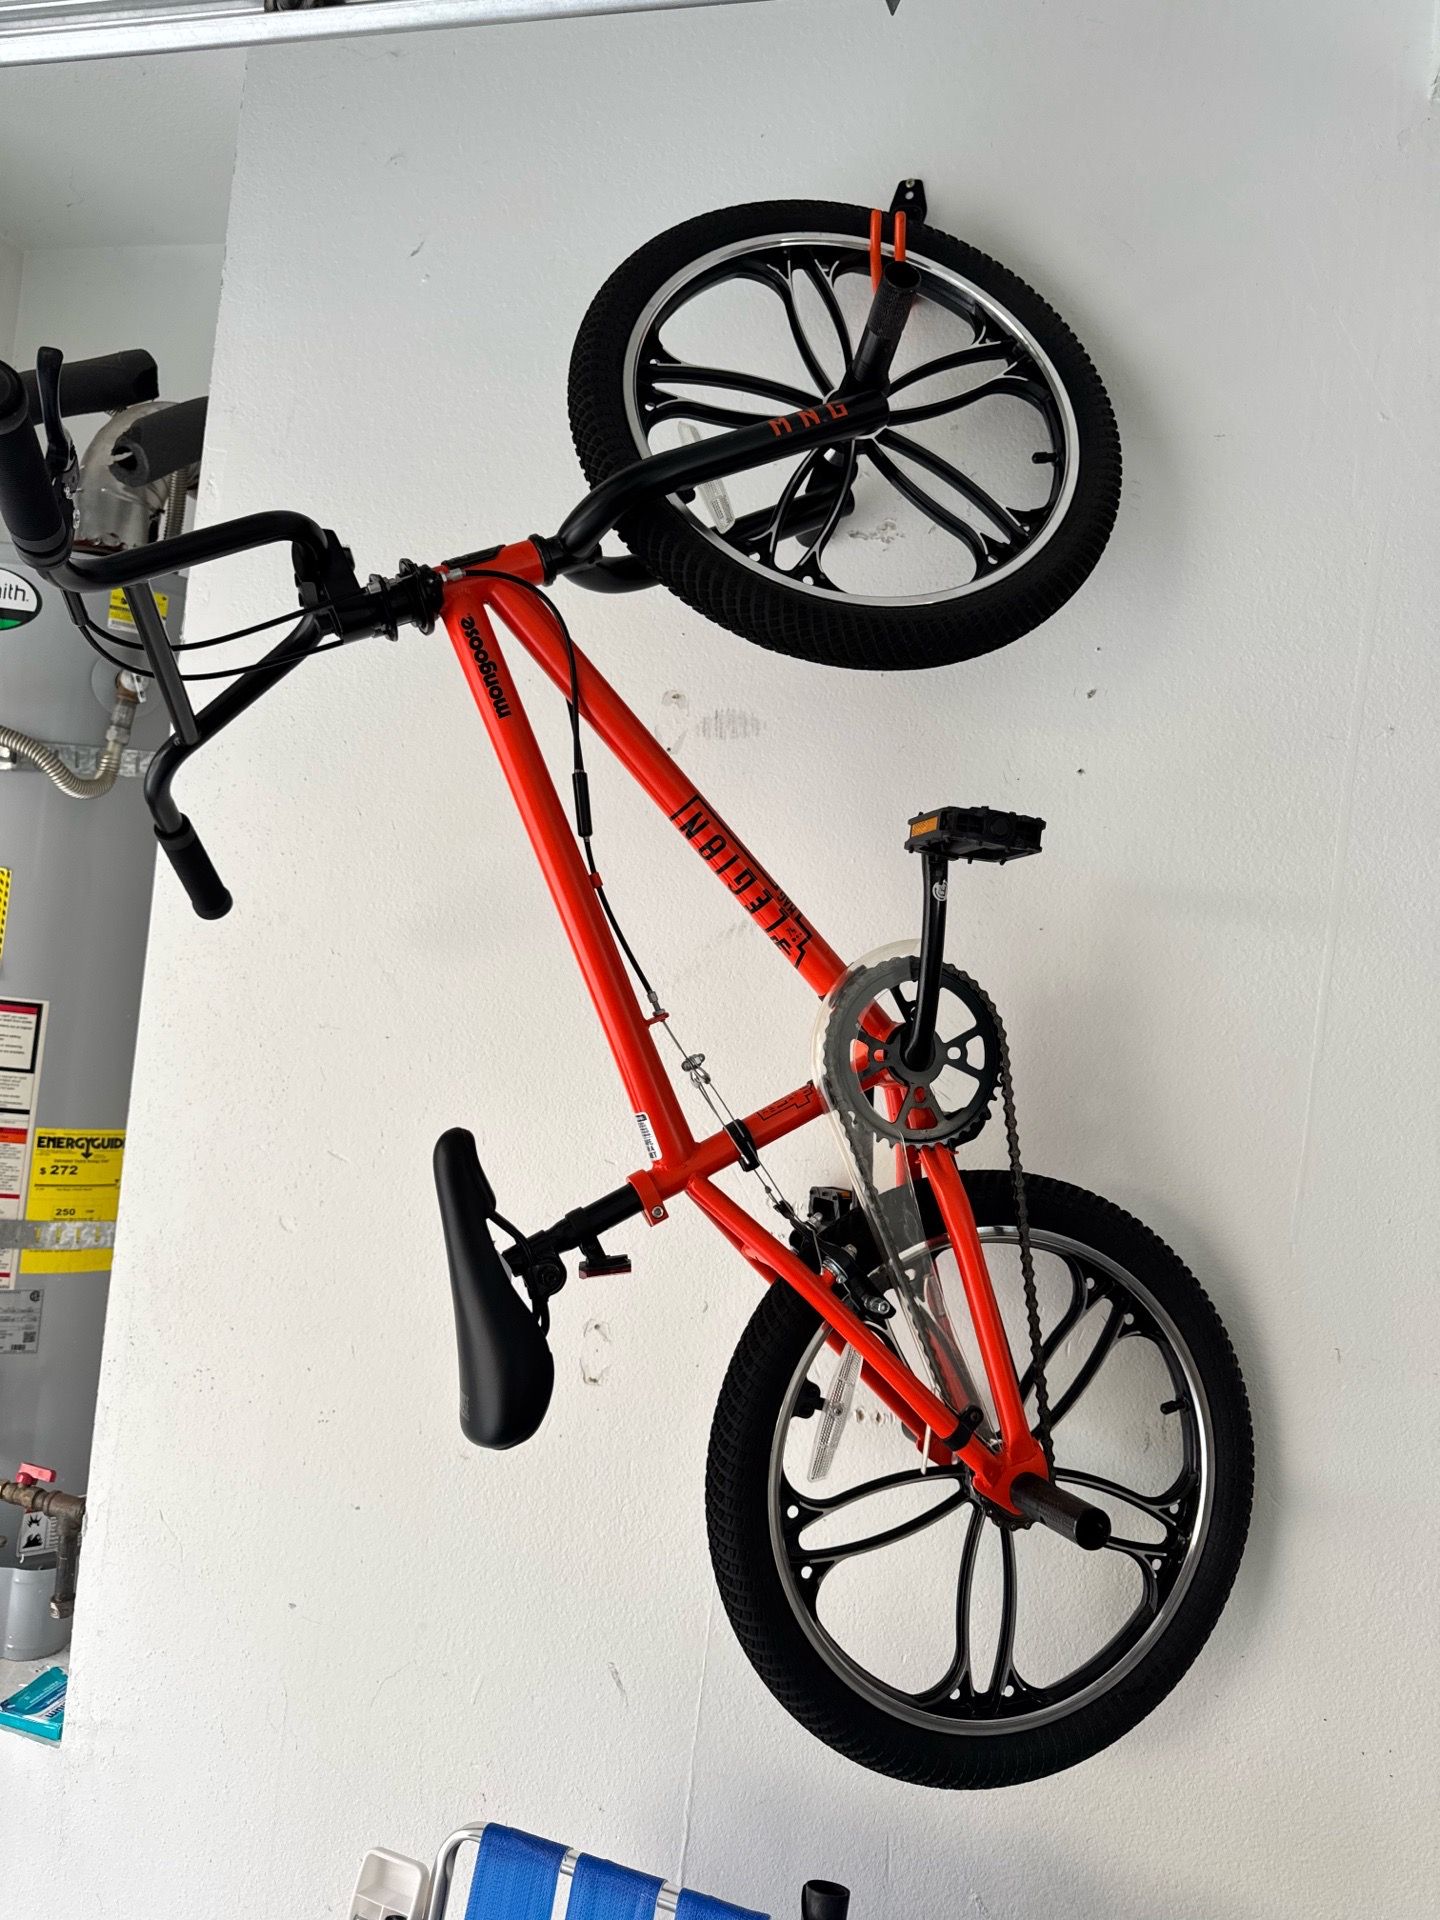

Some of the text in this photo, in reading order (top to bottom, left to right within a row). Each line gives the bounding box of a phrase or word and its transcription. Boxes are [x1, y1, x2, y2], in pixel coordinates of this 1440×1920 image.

[768, 400, 849, 438] MNG
[460, 615, 513, 719] mongoose
[679, 811, 789, 934] LEGION
[37, 1136, 126, 1149] ENERGYGUID
[50, 1165, 78, 1175] 272
[55, 1208, 76, 1216] 250
